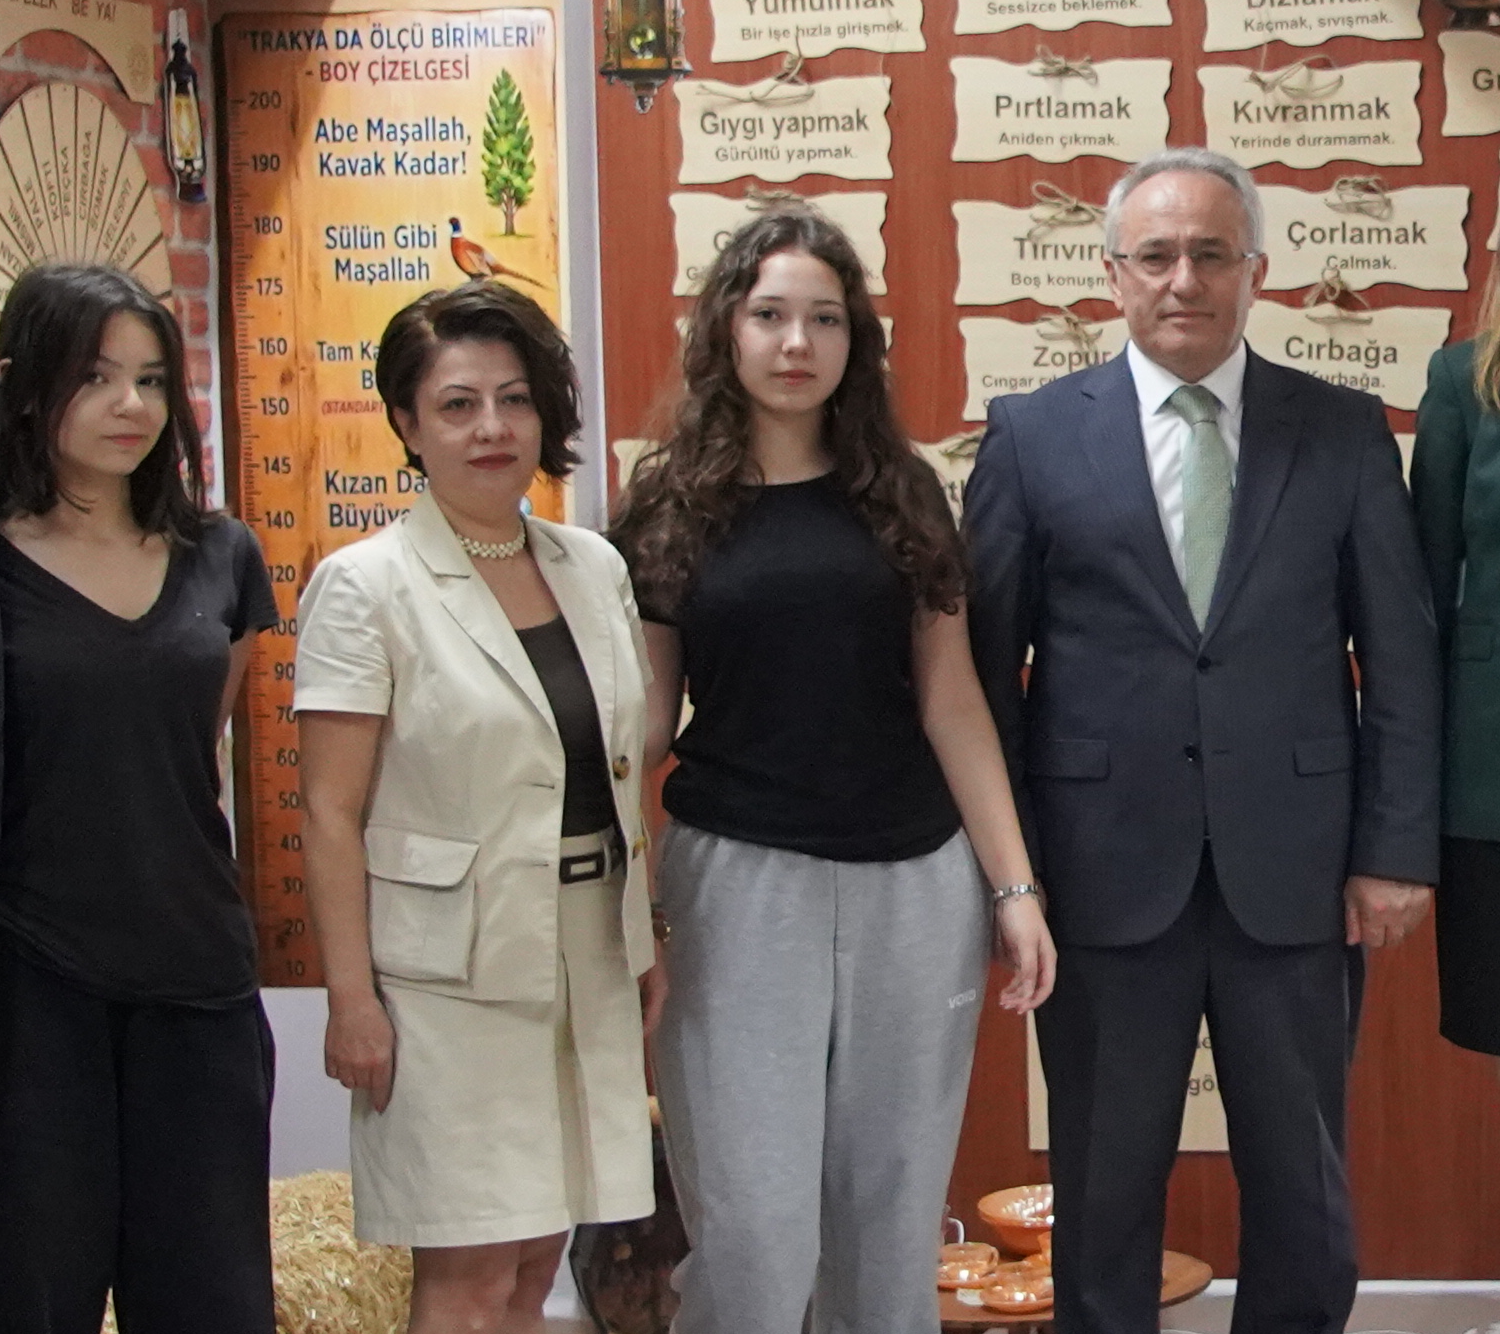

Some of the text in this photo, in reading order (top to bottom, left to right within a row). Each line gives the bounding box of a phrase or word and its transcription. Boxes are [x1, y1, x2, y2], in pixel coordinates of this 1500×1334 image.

[986, 0, 1058, 16] Sessizce
[1243, 11, 1394, 34] Kaçmak, sıvışmak.
[335, 29, 363, 51] DA
[369, 22, 425, 55] ÖLÇÜ
[740, 26, 764, 42] Bir
[319, 53, 470, 86] BOY ÇİZELGESİ
[248, 90, 282, 110] 200
[994, 94, 1132, 120] Pırtlamak
[1233, 96, 1391, 125] Kıvranmak
[314, 115, 473, 147] Abe Maşallah,
[699, 107, 870, 142] Gıygı yapmak
[998, 131, 1121, 150] Aniden çıkmak.
[1229, 131, 1396, 150] Yerinde duramamak.
[251, 154, 281, 173] 190
[714, 144, 858, 164] Gürültü yapmak.
[318, 151, 467, 178] Kavak Kadar!
[253, 216, 283, 235] 180
[324, 224, 438, 251] Sülün Gibi
[1287, 220, 1427, 252] Çorlamak
[334, 256, 431, 286] Maşallah
[1010, 272, 1042, 289] Boş
[255, 277, 284, 296] 175
[258, 337, 288, 356] 160
[316, 340, 354, 362] Tam
[1284, 334, 1399, 369] Cırbağa
[981, 374, 1034, 391] Cıngar
[260, 397, 290, 416] 150
[263, 456, 292, 475] 145
[325, 469, 388, 495] Kızan
[265, 511, 295, 529] 140
[274, 662, 296, 681] 90
[276, 705, 297, 725] 70
[276, 748, 299, 767] 60
[278, 790, 300, 810] 50
[280, 834, 302, 853] 40
